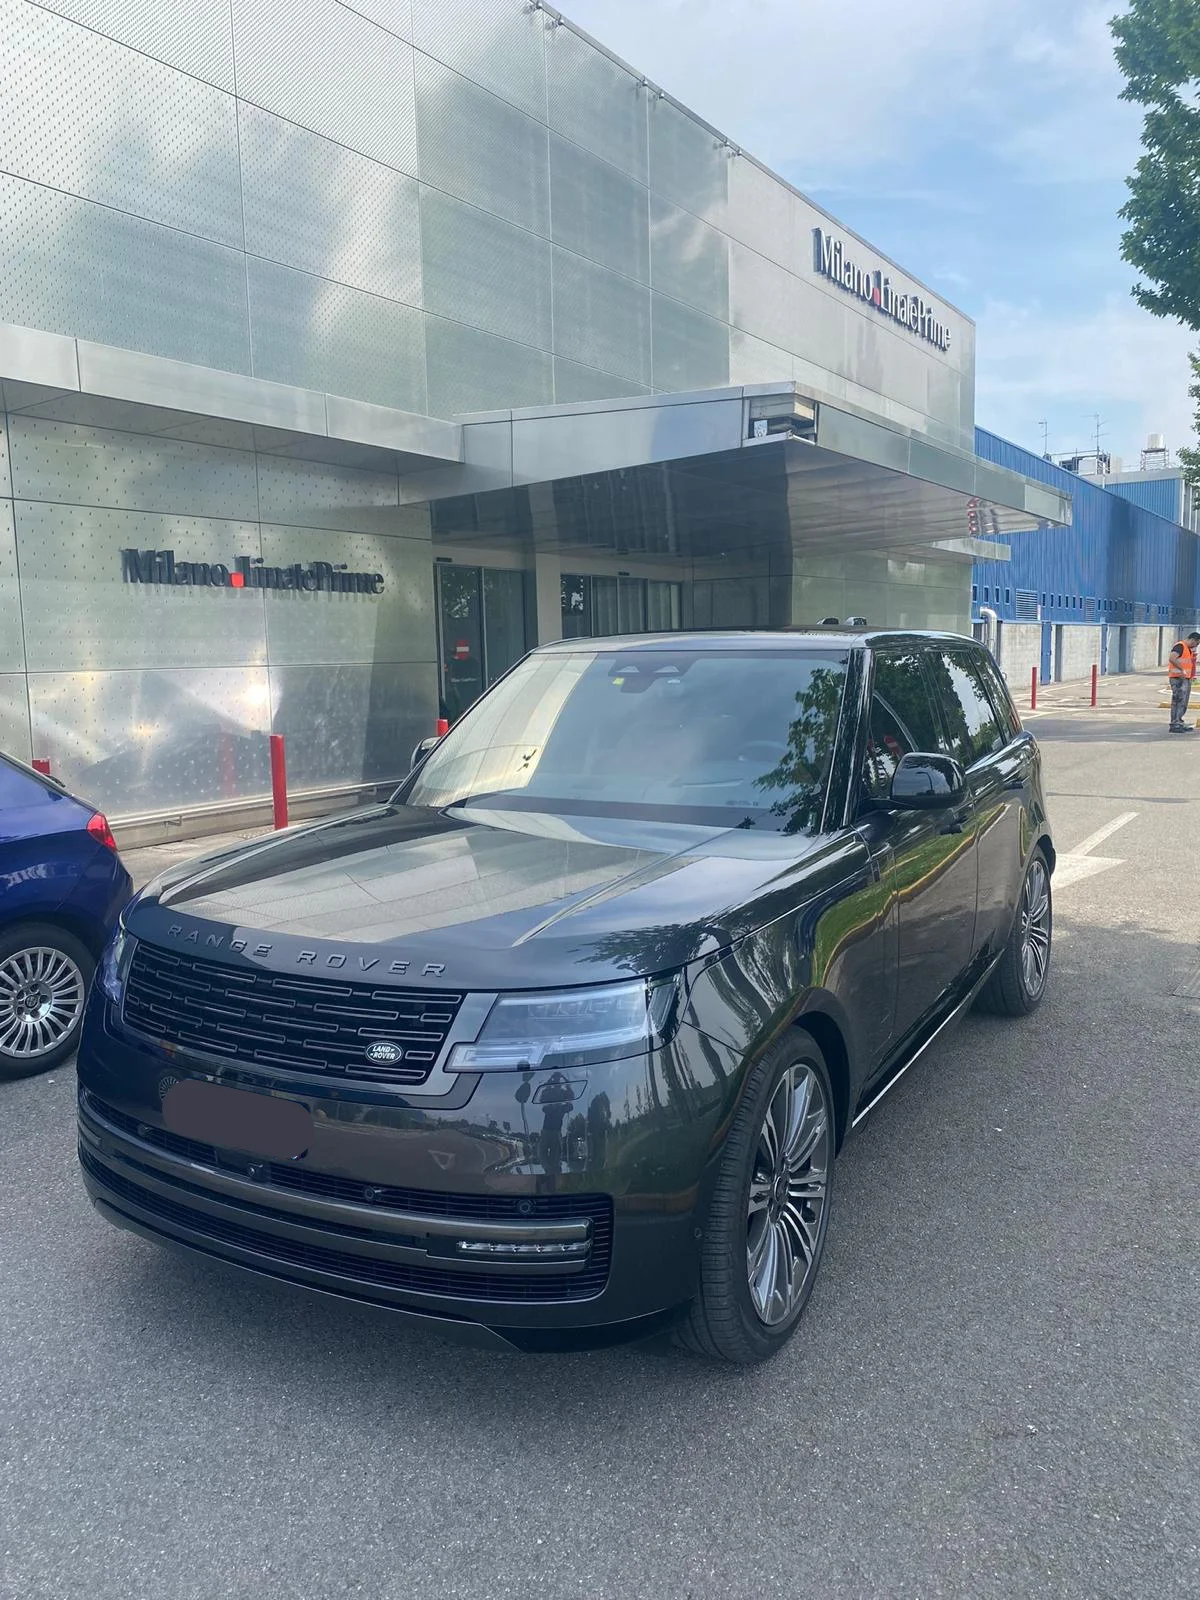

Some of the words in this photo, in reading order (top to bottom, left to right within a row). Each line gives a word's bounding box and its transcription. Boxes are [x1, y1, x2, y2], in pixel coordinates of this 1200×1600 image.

[812, 227, 873, 301] Milano
[122, 549, 230, 587] Milano
[168, 924, 272, 957] RANGE
[297, 950, 446, 977] ROVER
[372, 1052, 396, 1060] ROVER
